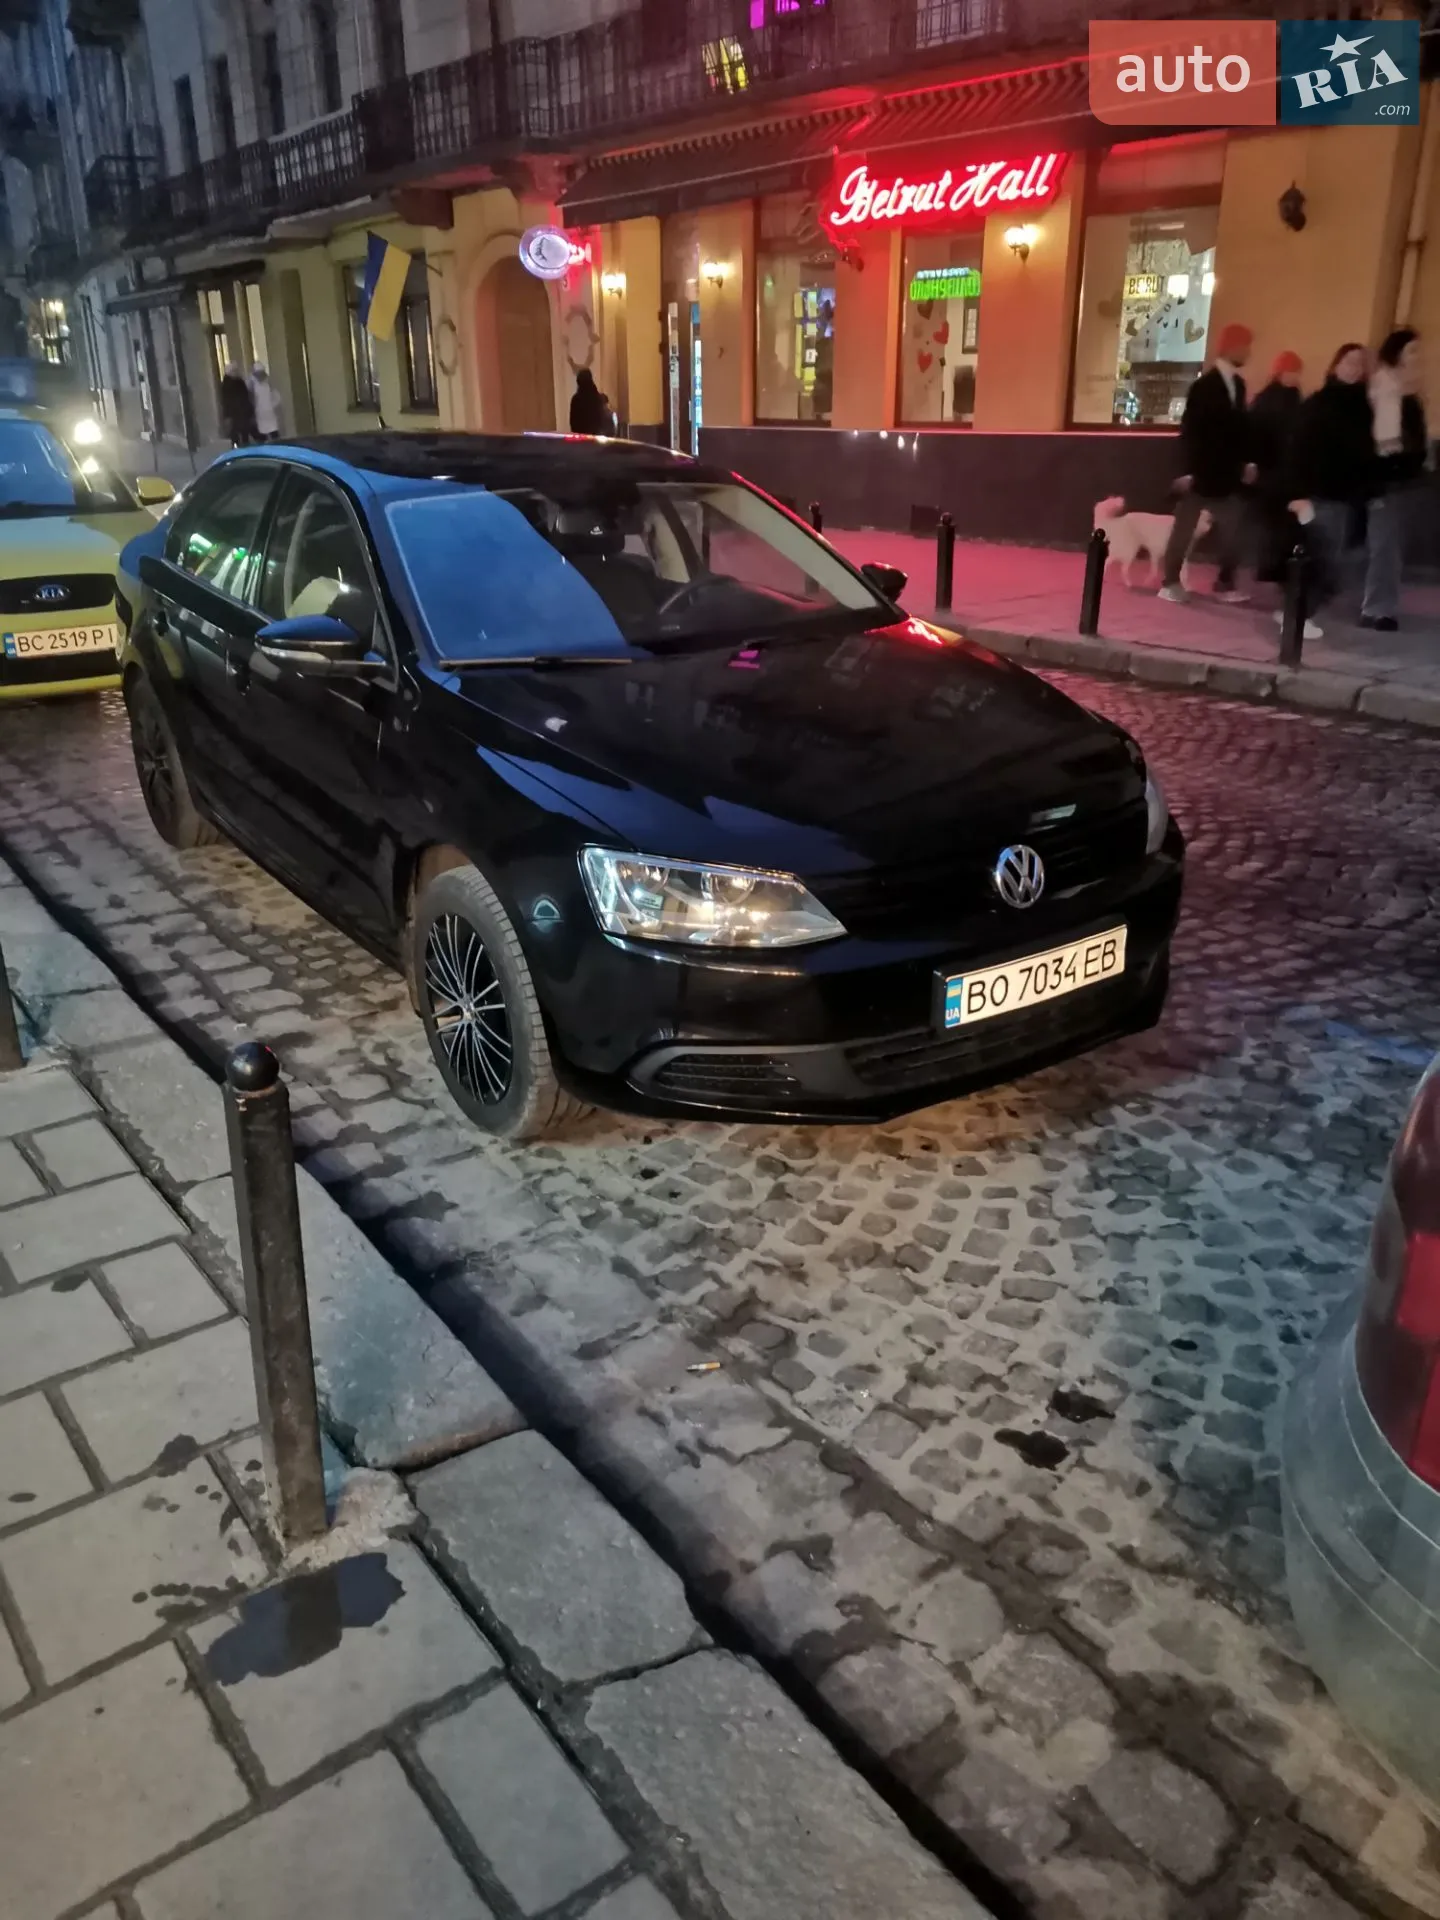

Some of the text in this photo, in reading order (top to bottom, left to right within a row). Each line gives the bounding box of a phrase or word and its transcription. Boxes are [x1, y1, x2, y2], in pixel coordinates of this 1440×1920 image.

[830, 153, 1057, 225] Beirut Hall
[41, 588, 65, 599] KIA
[17, 635, 44, 652] BC
[48, 631, 87, 650] 2519
[967, 938, 1117, 1015] BO 7034 EB
[945, 1008, 961, 1020] UA
